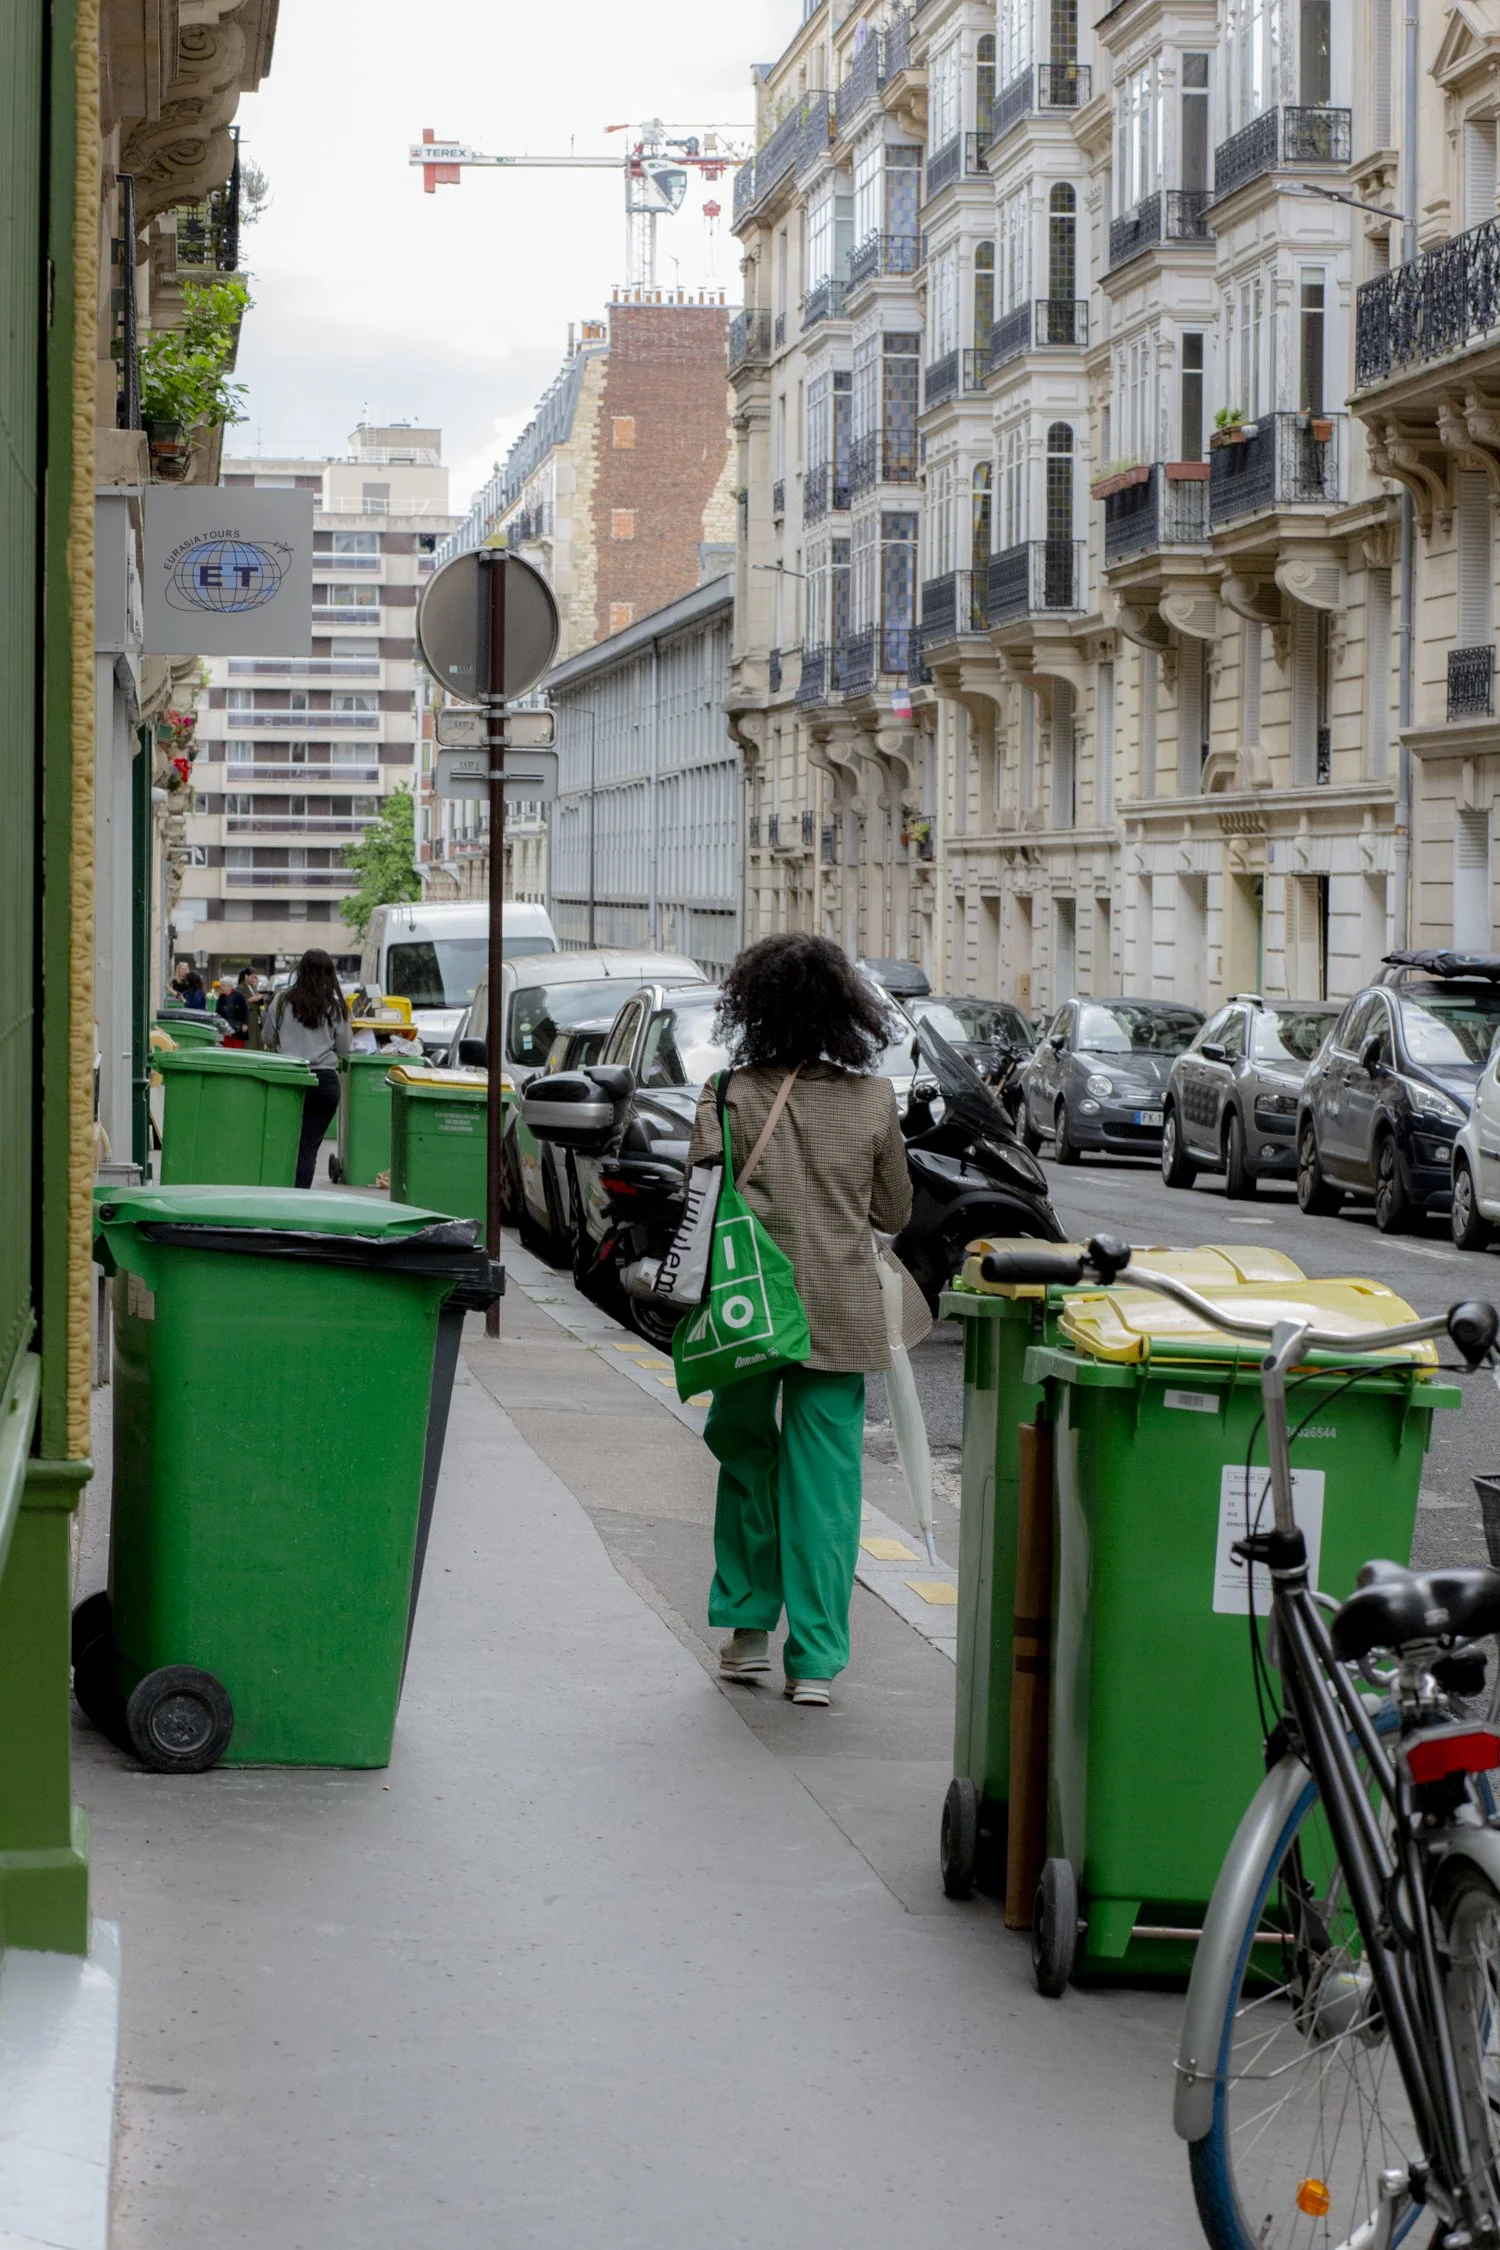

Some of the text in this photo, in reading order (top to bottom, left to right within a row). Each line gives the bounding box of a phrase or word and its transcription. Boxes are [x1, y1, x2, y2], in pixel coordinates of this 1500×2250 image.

[425, 148, 467, 158] TEREX
[163, 529, 241, 571] EURASIA TOURS
[734, 1352, 768, 1370] Alitalia
